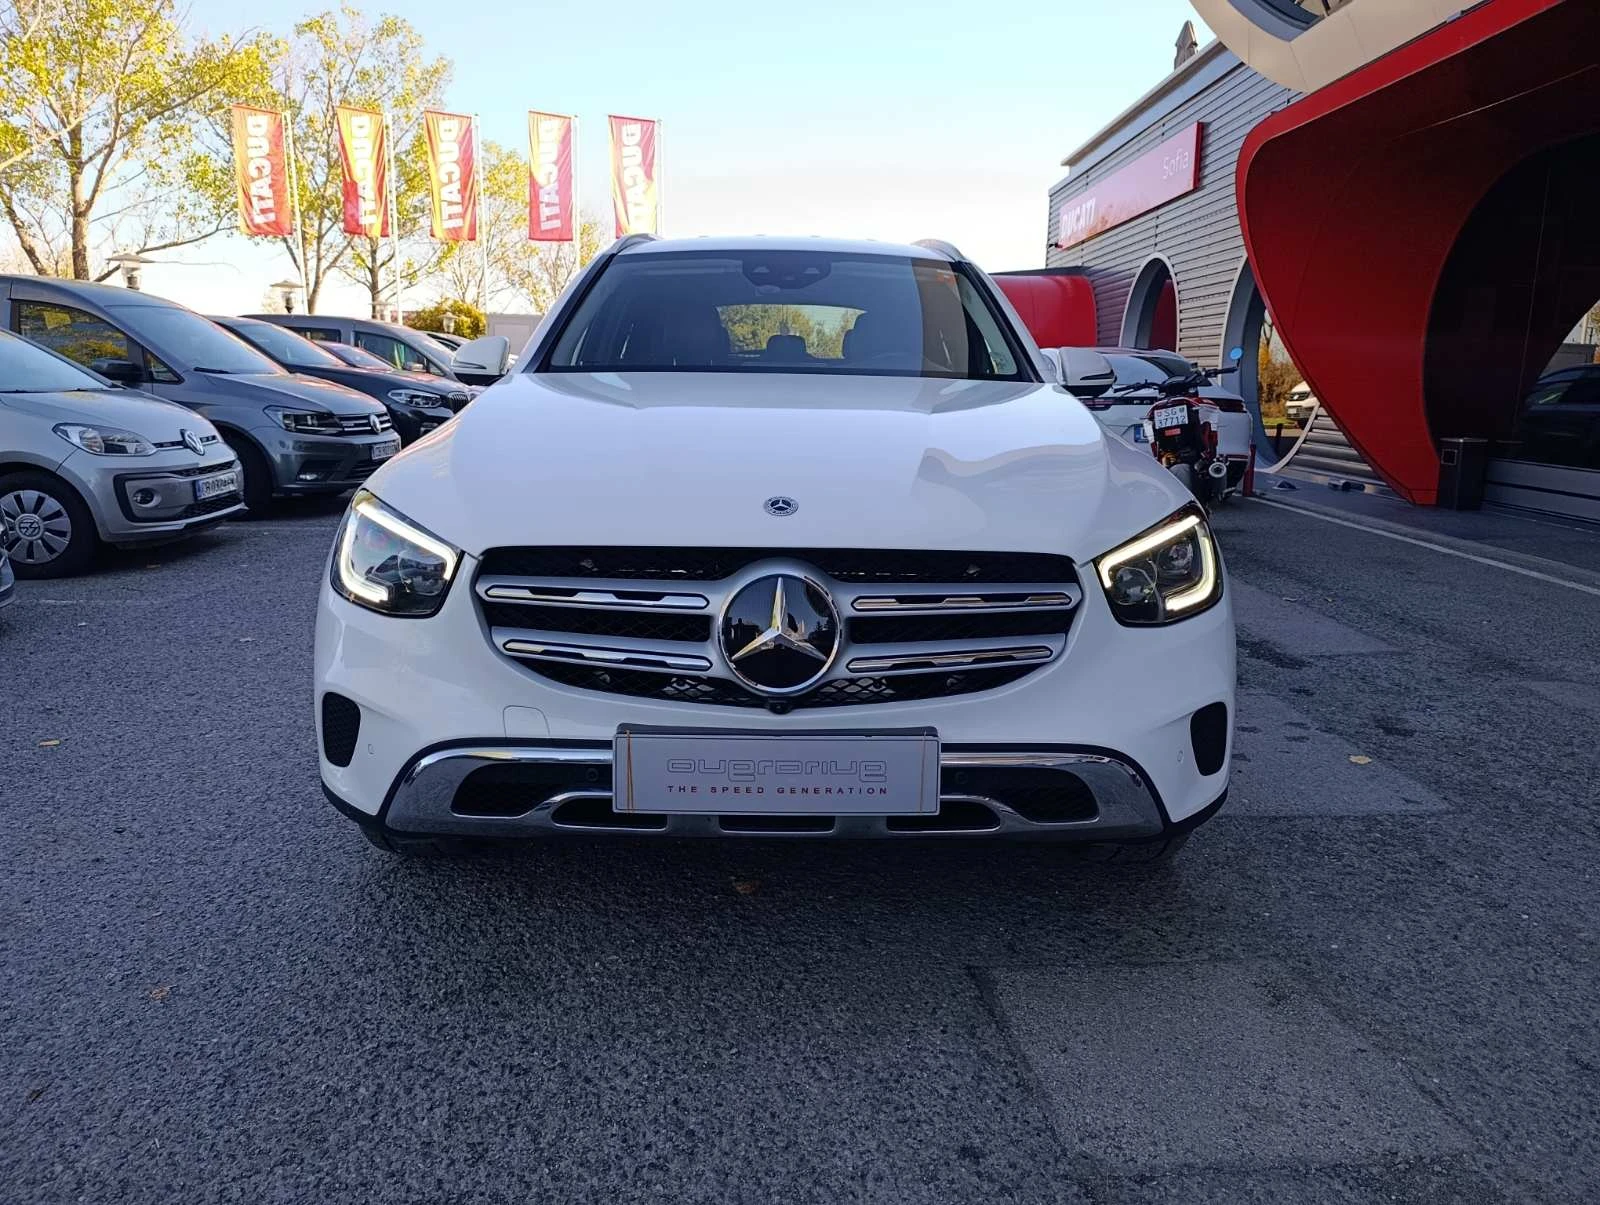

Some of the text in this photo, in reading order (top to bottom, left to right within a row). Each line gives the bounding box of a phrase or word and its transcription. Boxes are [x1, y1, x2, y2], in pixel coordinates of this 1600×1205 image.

[1060, 147, 1190, 240] DUCATI Sofia
[667, 785, 889, 795] THE SPEED GENERATION
